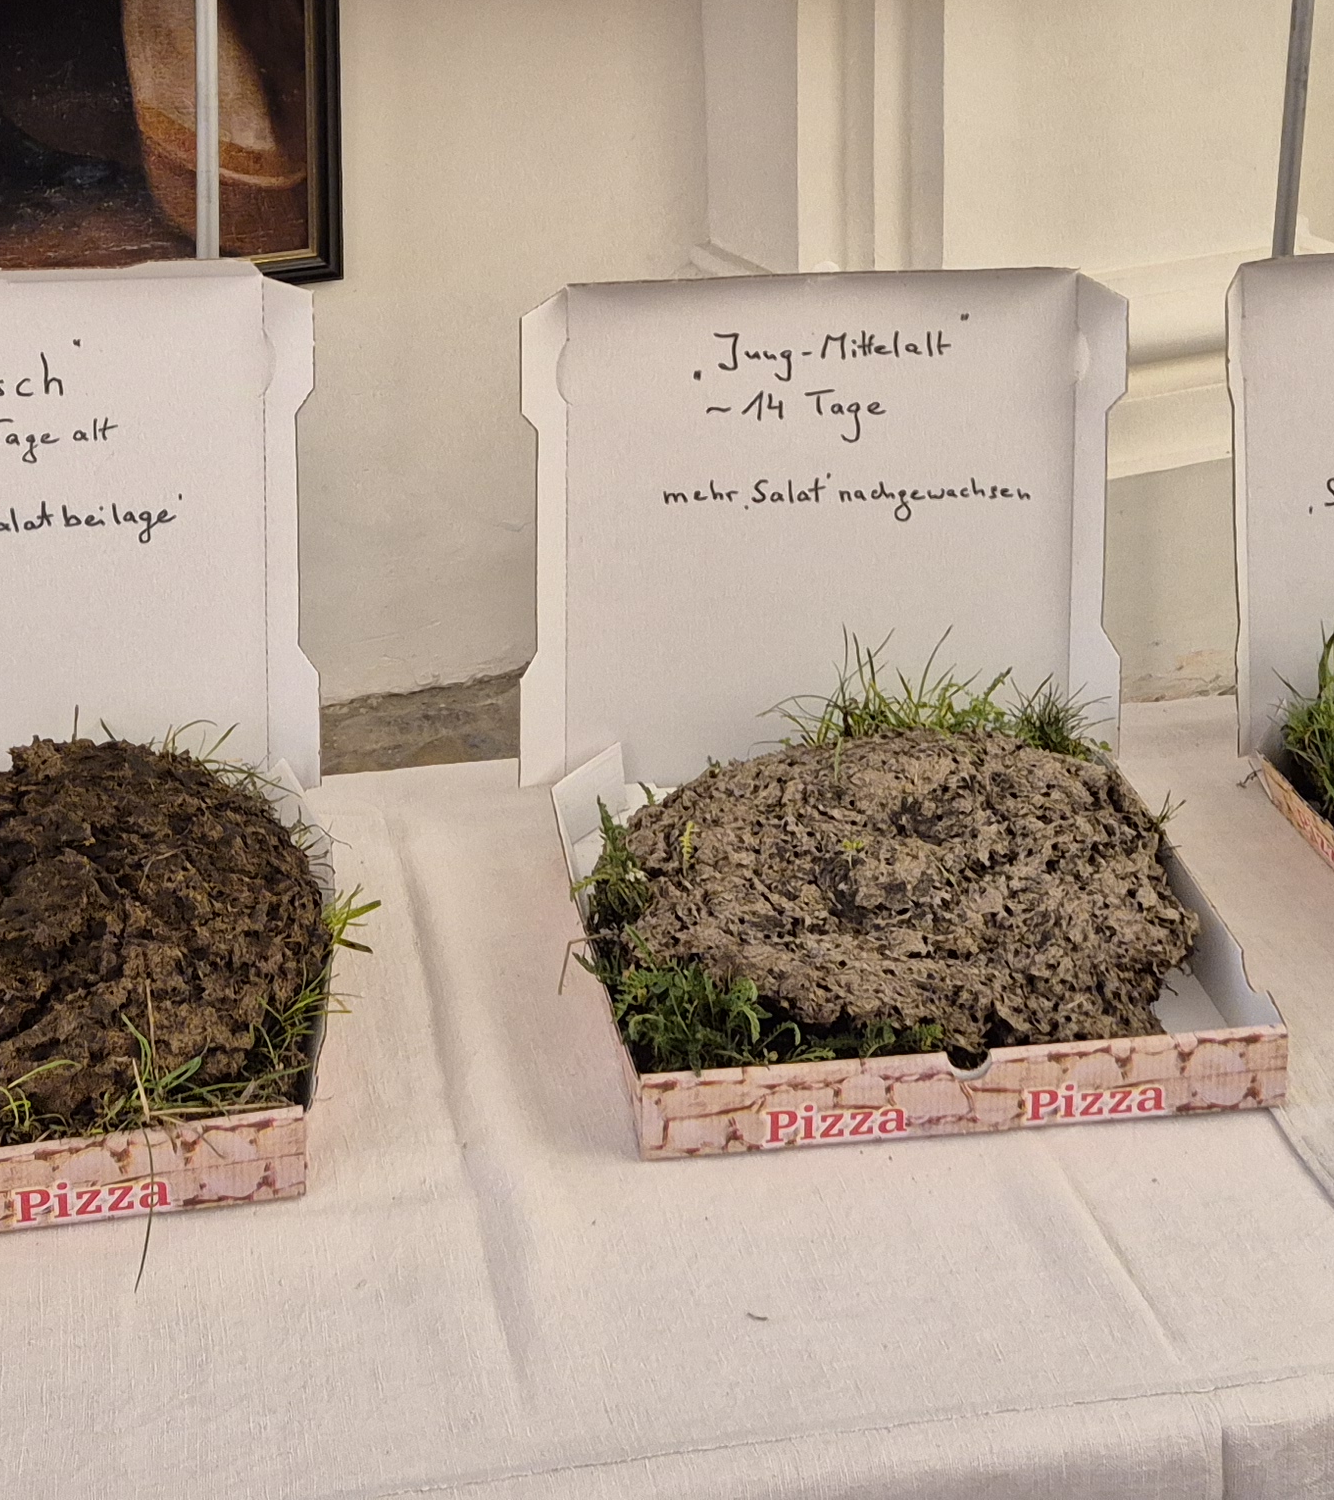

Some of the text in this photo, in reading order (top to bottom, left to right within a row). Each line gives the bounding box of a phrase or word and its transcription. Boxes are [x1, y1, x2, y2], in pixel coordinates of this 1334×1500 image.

[72, 417, 119, 443] alt
[741, 387, 888, 443] 14 Tage
[662, 478, 739, 505] mehr
[837, 476, 1033, 523] nachgewachsen
[764, 1082, 1167, 1145] Pizza Pizza
[13, 1177, 173, 1224] Pizza
